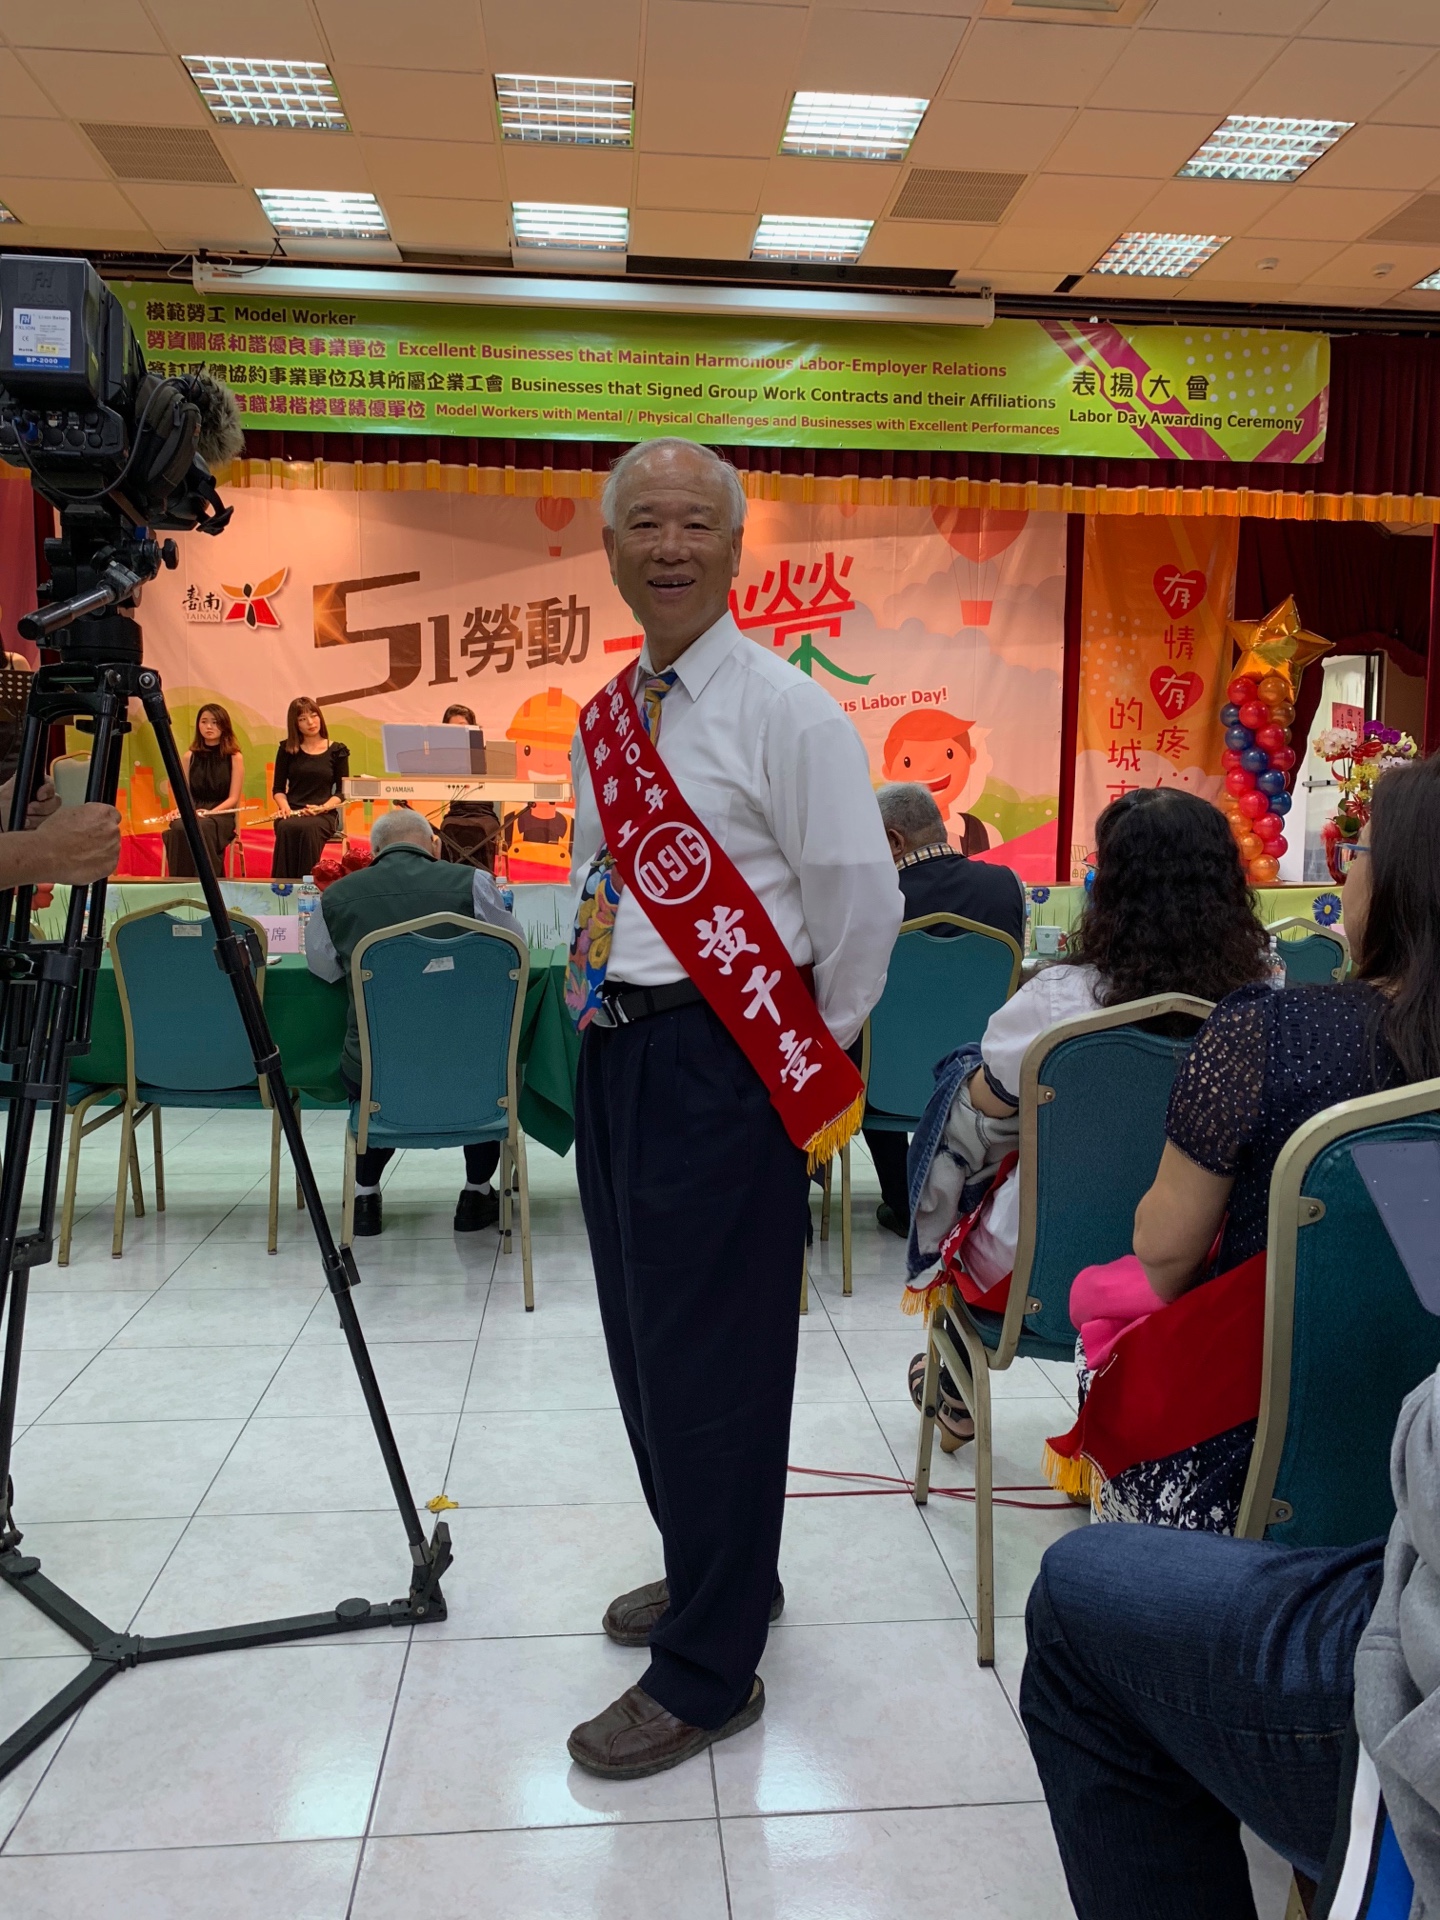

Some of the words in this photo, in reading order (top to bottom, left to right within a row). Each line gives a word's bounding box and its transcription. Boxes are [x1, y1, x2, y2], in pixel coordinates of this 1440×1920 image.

[146, 301, 226, 323] 模範勞工
[234, 306, 287, 323] Model
[292, 309, 356, 326] Worker
[147, 330, 387, 358] 勞資關係和諧優良事業單位
[399, 342, 477, 358] Excellent
[481, 344, 574, 362] Businesses
[578, 348, 613, 363] that
[618, 350, 690, 366] Maintain
[695, 353, 794, 370] Harmonious
[799, 358, 928, 377] Labor-Employer
[932, 361, 1007, 377] Relations
[511, 377, 603, 395] Businesses
[607, 380, 643, 396] that
[647, 382, 703, 399] Signed
[708, 385, 758, 402] Group
[763, 386, 806, 401] Work
[811, 388, 889, 405] Contracts
[892, 390, 923, 406] and
[927, 391, 965, 407] their
[970, 393, 1057, 409] Affiliations
[1072, 370, 1209, 401] 表揚大會
[436, 404, 477, 417] Model
[481, 405, 539, 419] Workers
[542, 407, 573, 420] with
[577, 409, 623, 422] Mental
[638, 411, 693, 427] Physical
[697, 412, 769, 428] Challenges
[772, 415, 798, 428] and
[801, 416, 873, 430] Businesses
[876, 418, 906, 431] with
[909, 419, 968, 433] Excellent
[971, 421, 1060, 435] Performances
[1069, 408, 1113, 424] Labor
[1117, 411, 1148, 427] Day
[1150, 412, 1223, 430] Awarding
[1227, 414, 1303, 432] Ceremony
[182, 584, 220, 611] 臺南
[861, 694, 907, 711] Labor
[911, 687, 947, 705] Day!
[639, 828, 707, 897] 096
